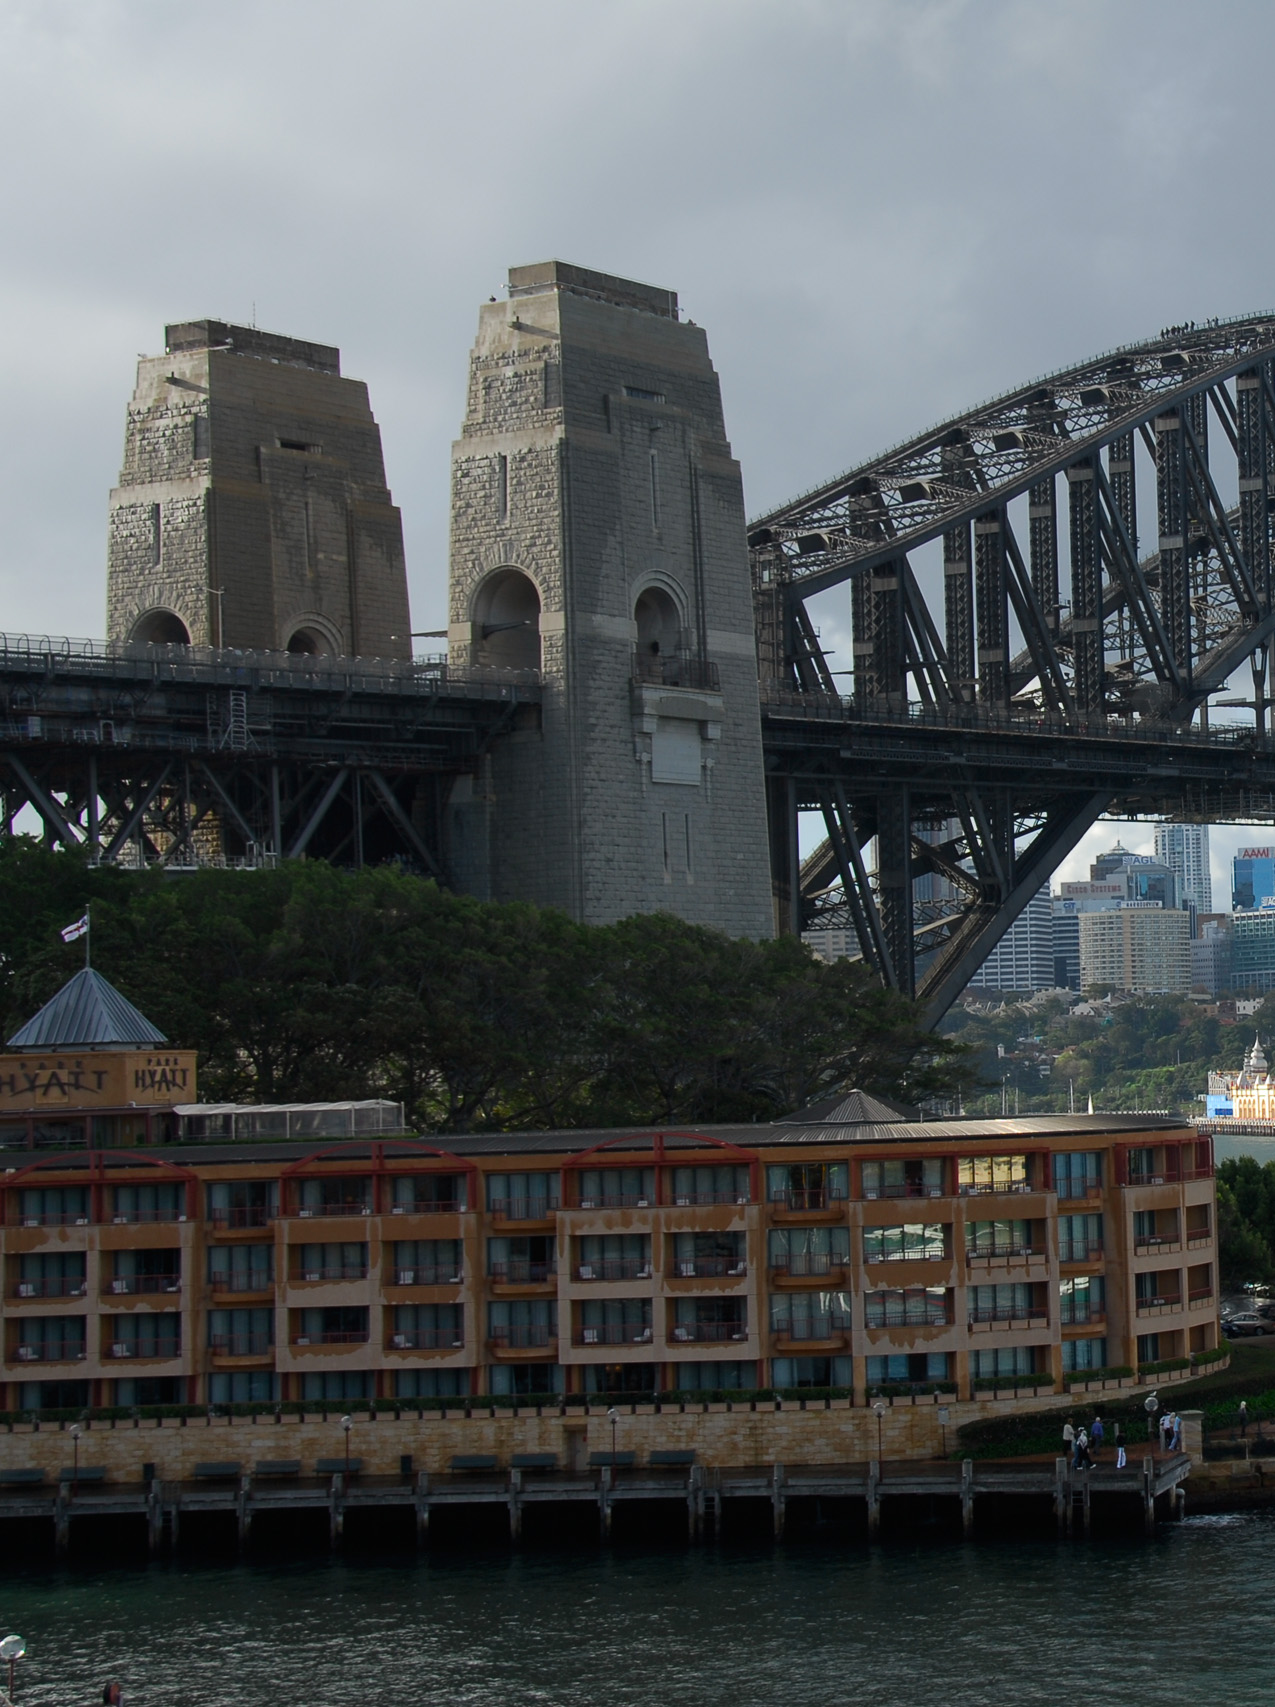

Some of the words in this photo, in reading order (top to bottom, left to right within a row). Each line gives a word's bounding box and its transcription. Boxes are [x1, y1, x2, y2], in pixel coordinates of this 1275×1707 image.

[1242, 847, 1270, 859] AAMI
[1133, 856, 1156, 865] AGL
[147, 1057, 179, 1067] PARK
[0, 1069, 109, 1097] HYATT
[135, 1067, 190, 1093] HYATT
